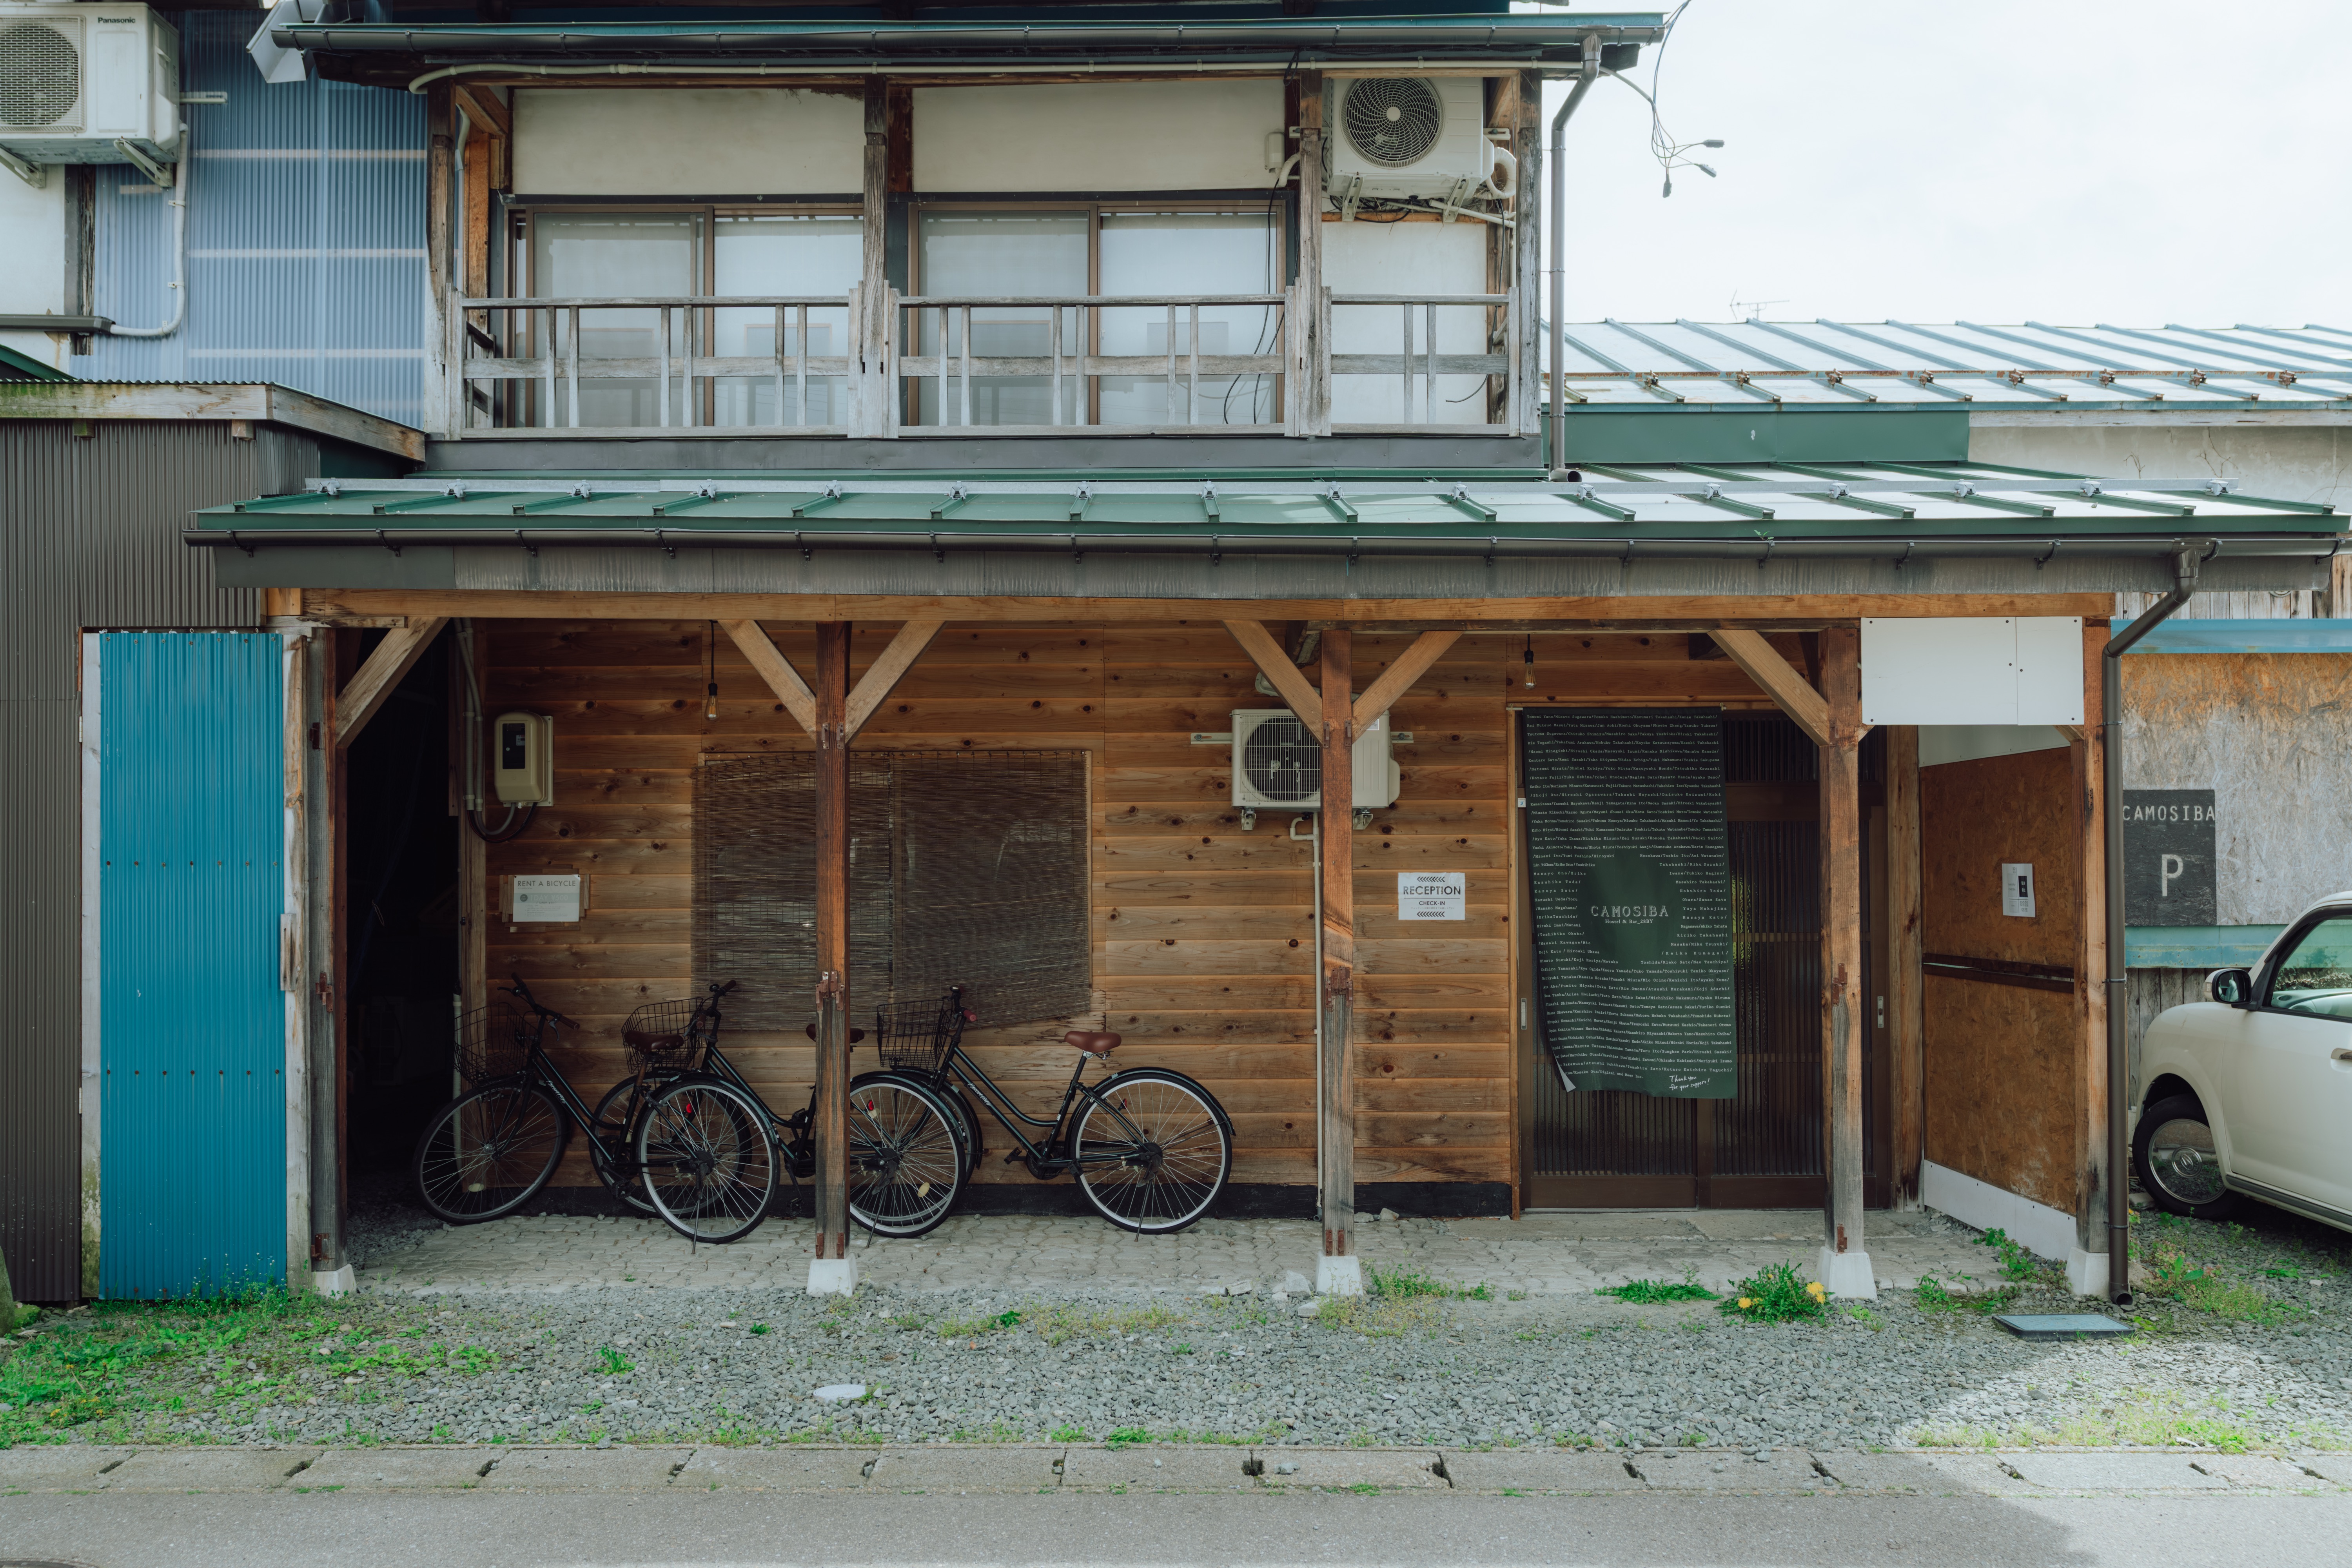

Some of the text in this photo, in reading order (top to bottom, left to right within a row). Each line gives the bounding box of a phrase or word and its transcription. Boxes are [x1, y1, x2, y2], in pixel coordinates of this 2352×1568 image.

[2123, 806, 2215, 820] CAMOSIBA
[2162, 854, 2183, 897] P
[1403, 886, 1461, 895] RECEPTION
[1590, 905, 1669, 917] CAMOSIBA
